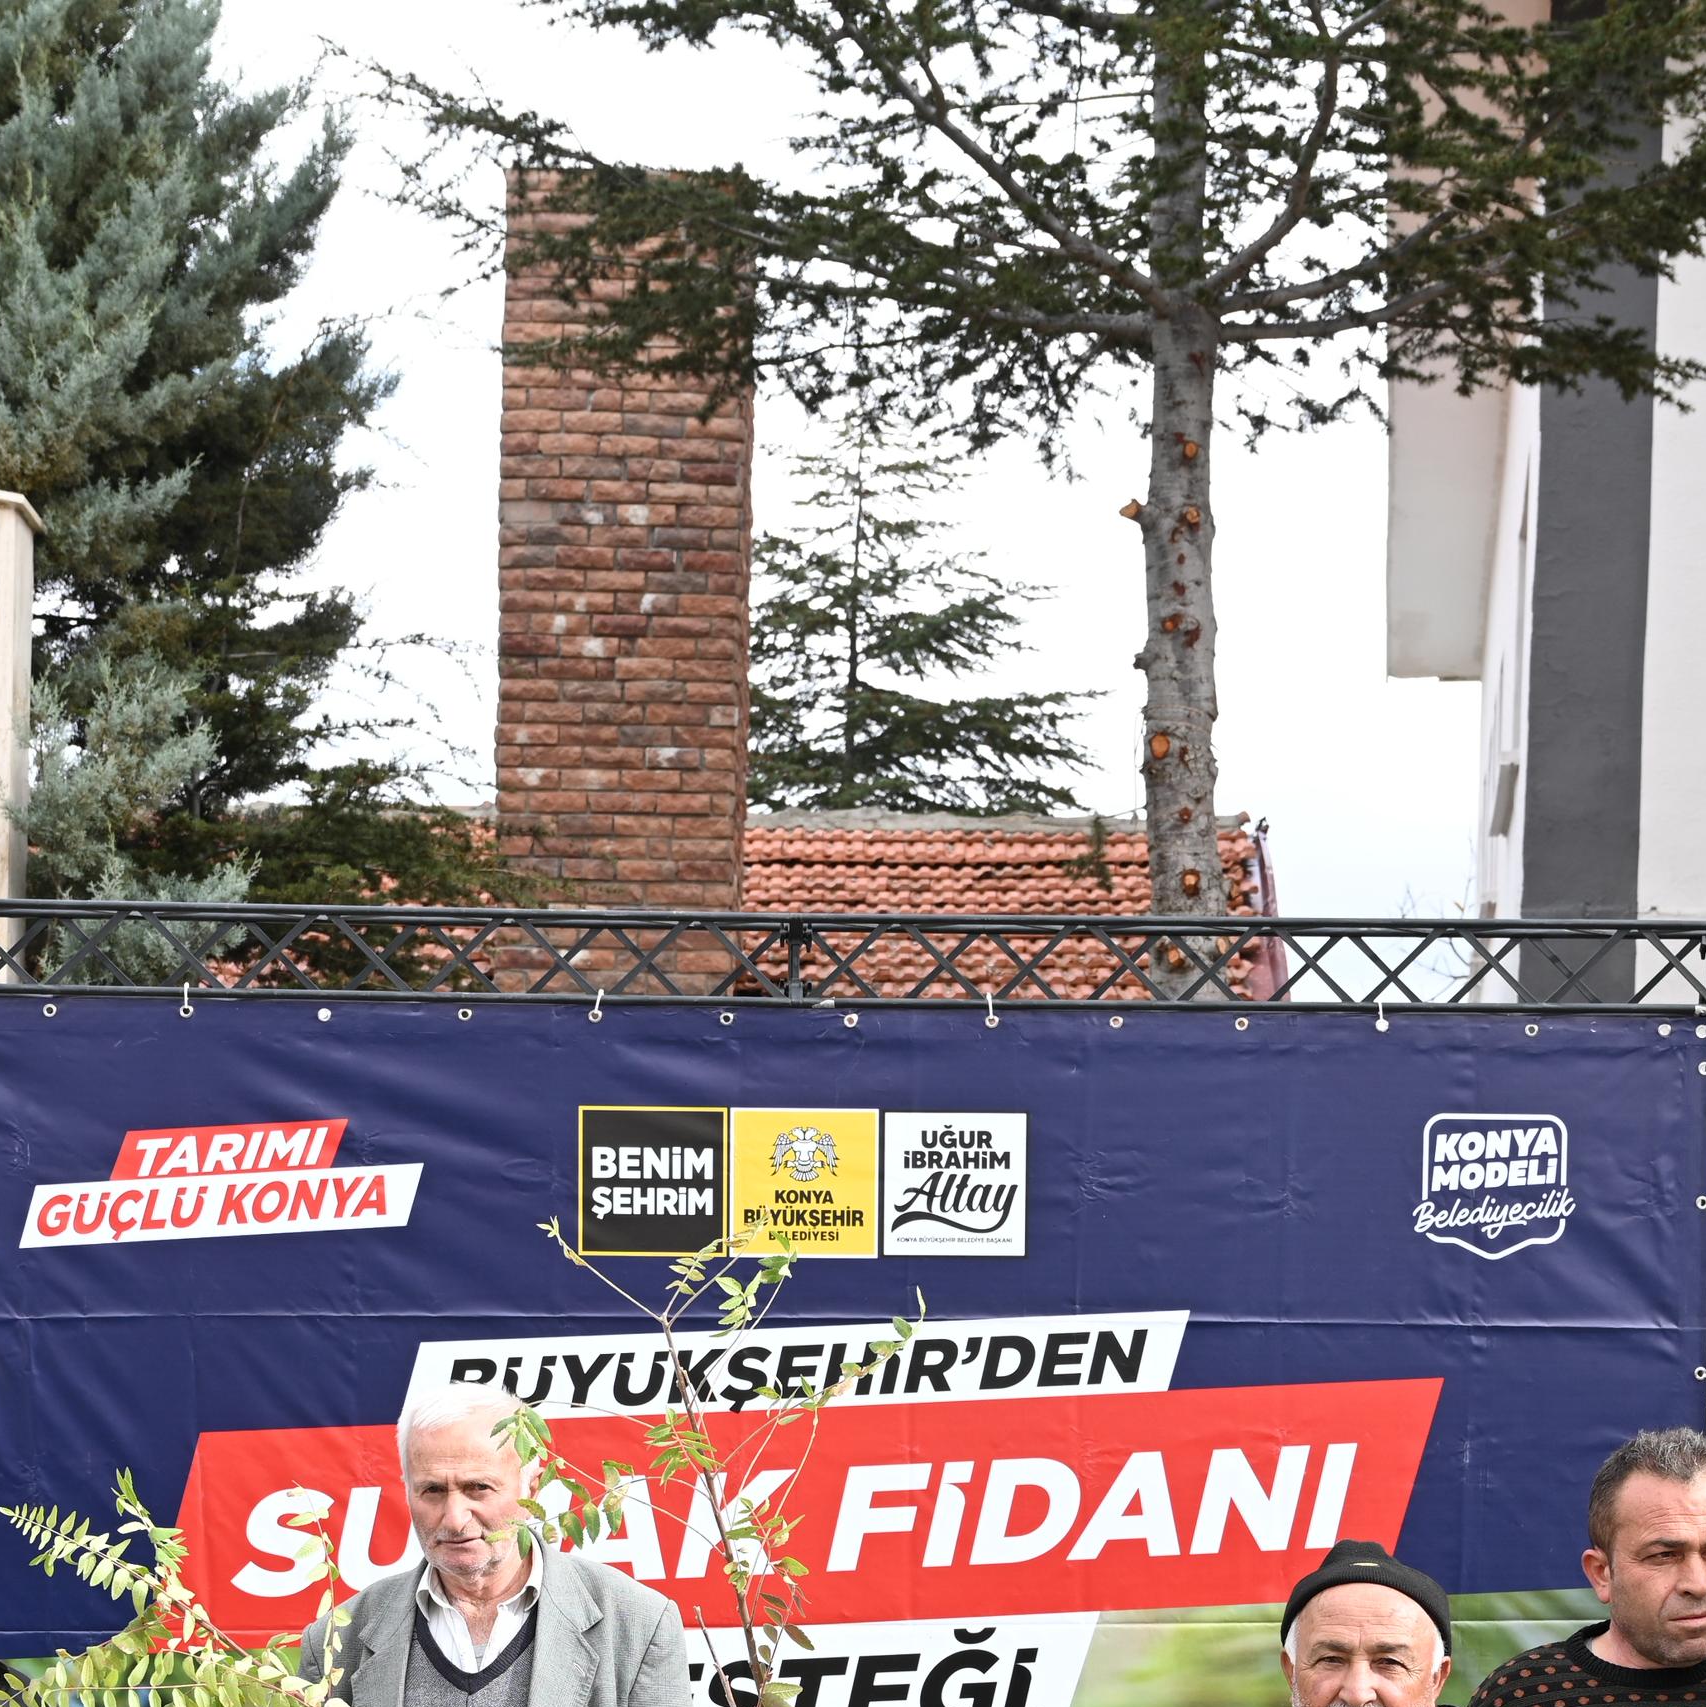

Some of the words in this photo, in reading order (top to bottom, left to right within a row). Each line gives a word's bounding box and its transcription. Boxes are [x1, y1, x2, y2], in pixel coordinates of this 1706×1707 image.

[135, 1127, 328, 1177] TARIMI
[921, 1125, 992, 1148] UĞUR
[1434, 1127, 1558, 1162] KONYA
[37, 1186, 208, 1241] GÜÇLÜ
[217, 1175, 387, 1226] KONYA
[774, 1189, 834, 1204] KONYA
[891, 1171, 1018, 1233] Altay
[1412, 1188, 1576, 1239] Belediyecilik
[986, 1237, 1012, 1245] BAŞKANI
[230, 1468, 796, 1598] SUAK
